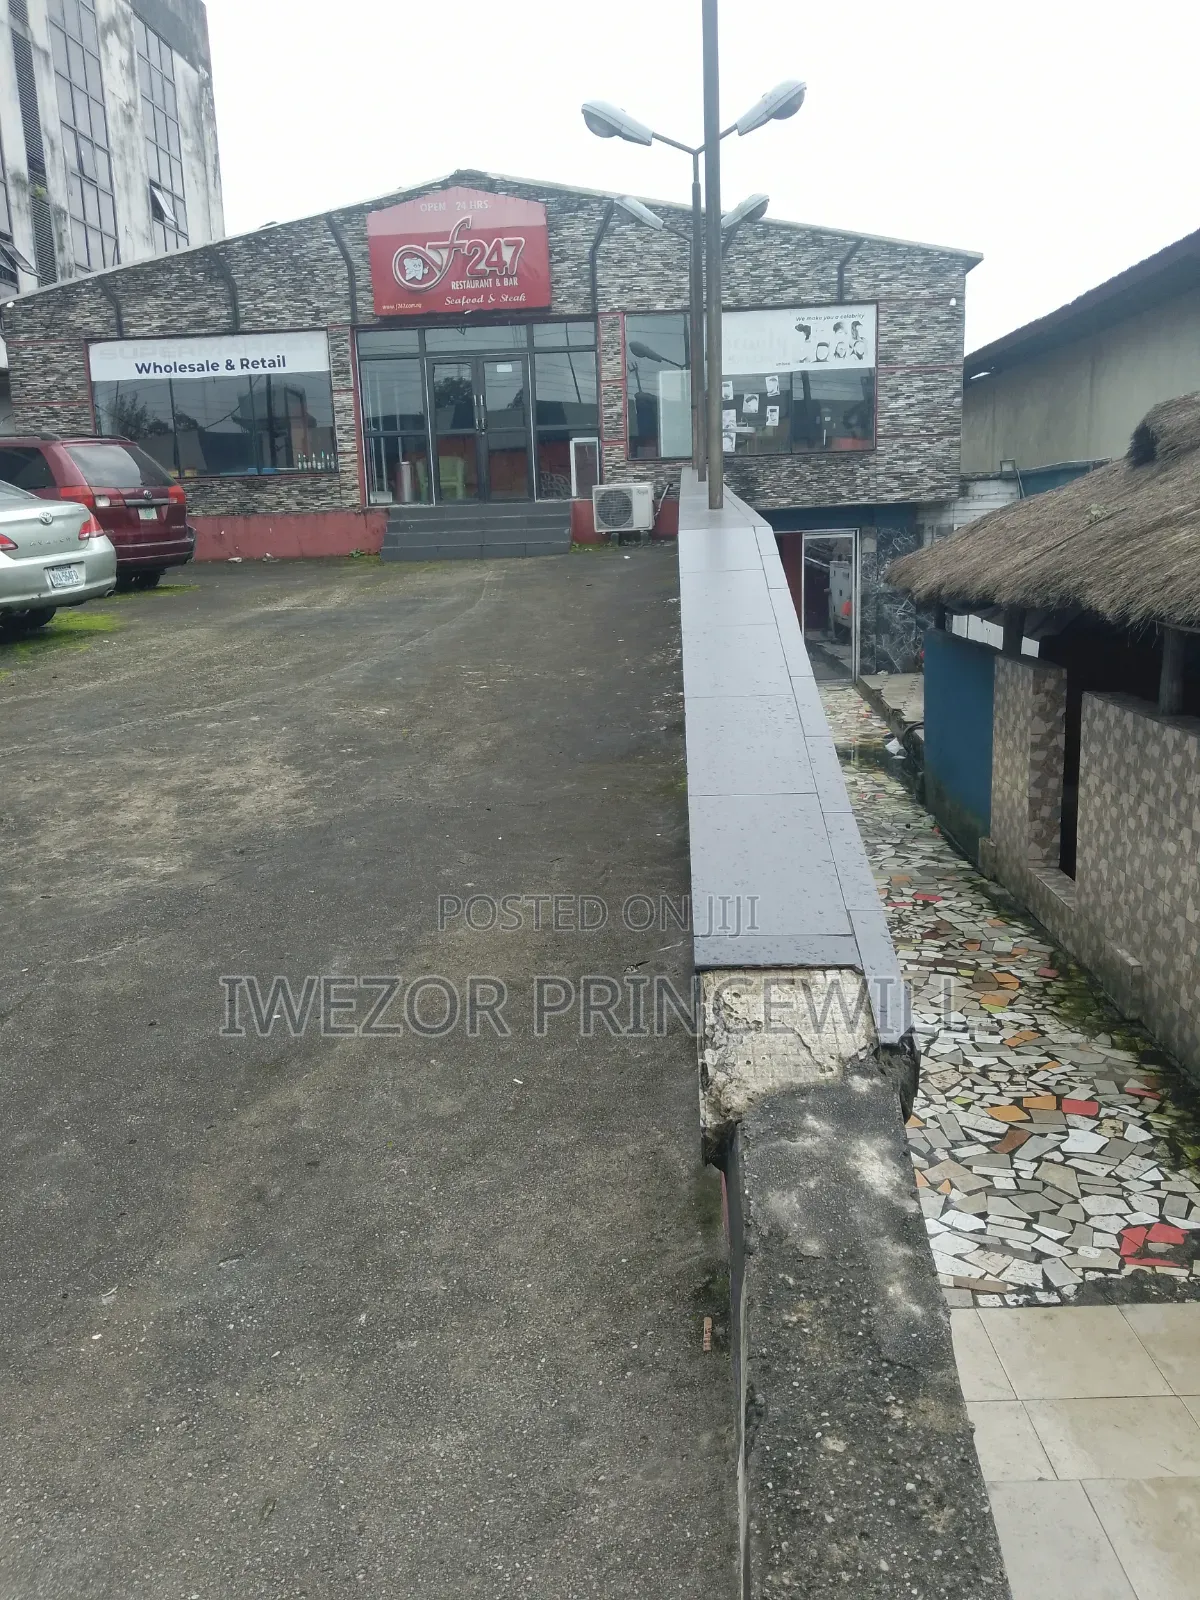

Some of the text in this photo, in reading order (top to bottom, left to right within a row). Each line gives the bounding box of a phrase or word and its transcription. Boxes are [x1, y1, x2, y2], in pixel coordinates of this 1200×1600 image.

[420, 202, 446, 212] OPEN
[455, 201, 466, 211] 24
[451, 276, 519, 290] RESTAURANT & BAR
[444, 292, 527, 306] Seafood & Steak
[134, 354, 287, 375] Wholesale & Retail
